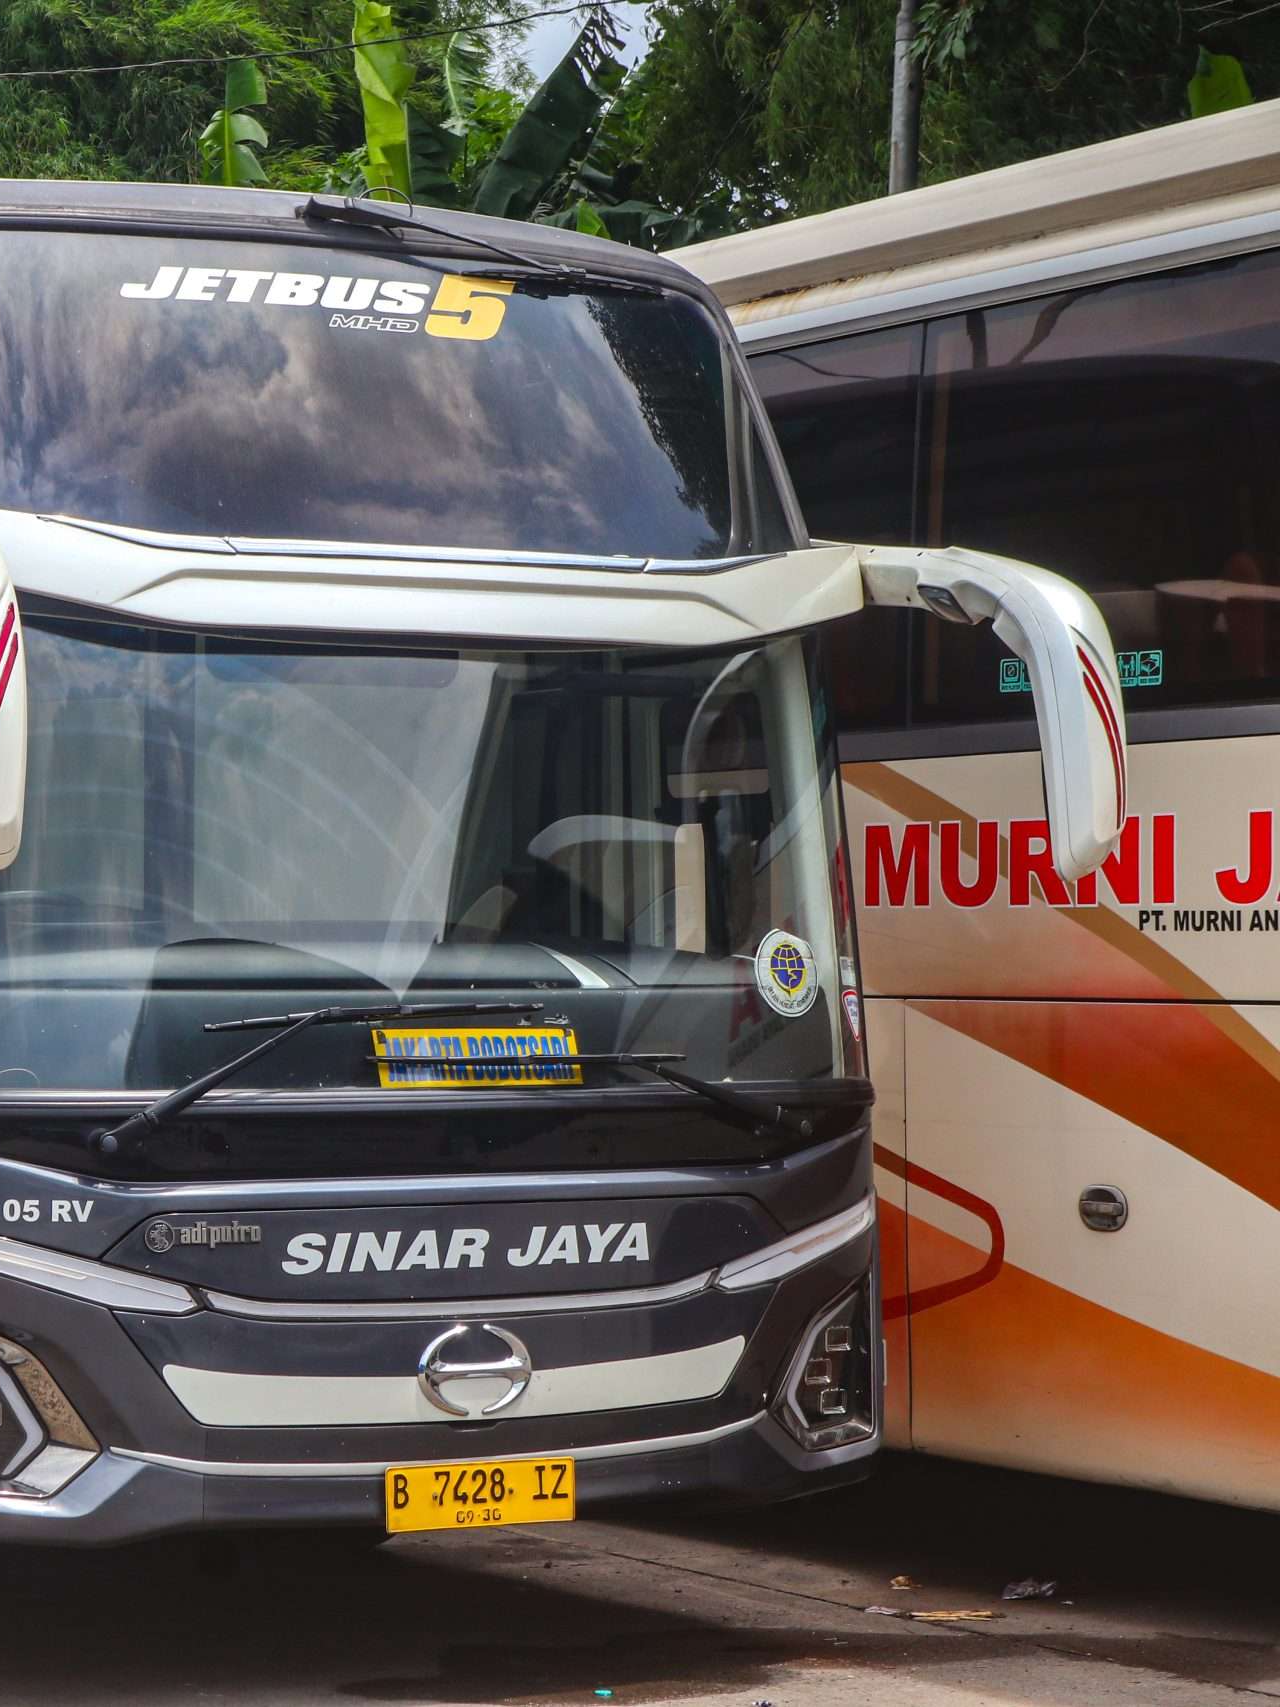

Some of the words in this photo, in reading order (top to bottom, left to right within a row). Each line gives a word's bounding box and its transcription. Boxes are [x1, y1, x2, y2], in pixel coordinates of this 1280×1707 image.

[120, 266, 430, 315] JETBUS
[424, 273, 518, 341] 5
[328, 313, 419, 334] MHD
[1213, 808, 1280, 906] J
[1139, 910, 1166, 932] PT.
[1173, 910, 1242, 932] MURNI
[385, 1036, 470, 1083] JAKARTA
[467, 1035, 575, 1081] BOBOTSARI
[2, 1199, 40, 1223] 05
[51, 1199, 94, 1223] RV
[281, 1227, 490, 1276] SINAR
[507, 1222, 650, 1267] JAYA
[393, 1473, 410, 1510] B
[434, 1468, 505, 1506] 7428
[532, 1464, 569, 1500] IZ
